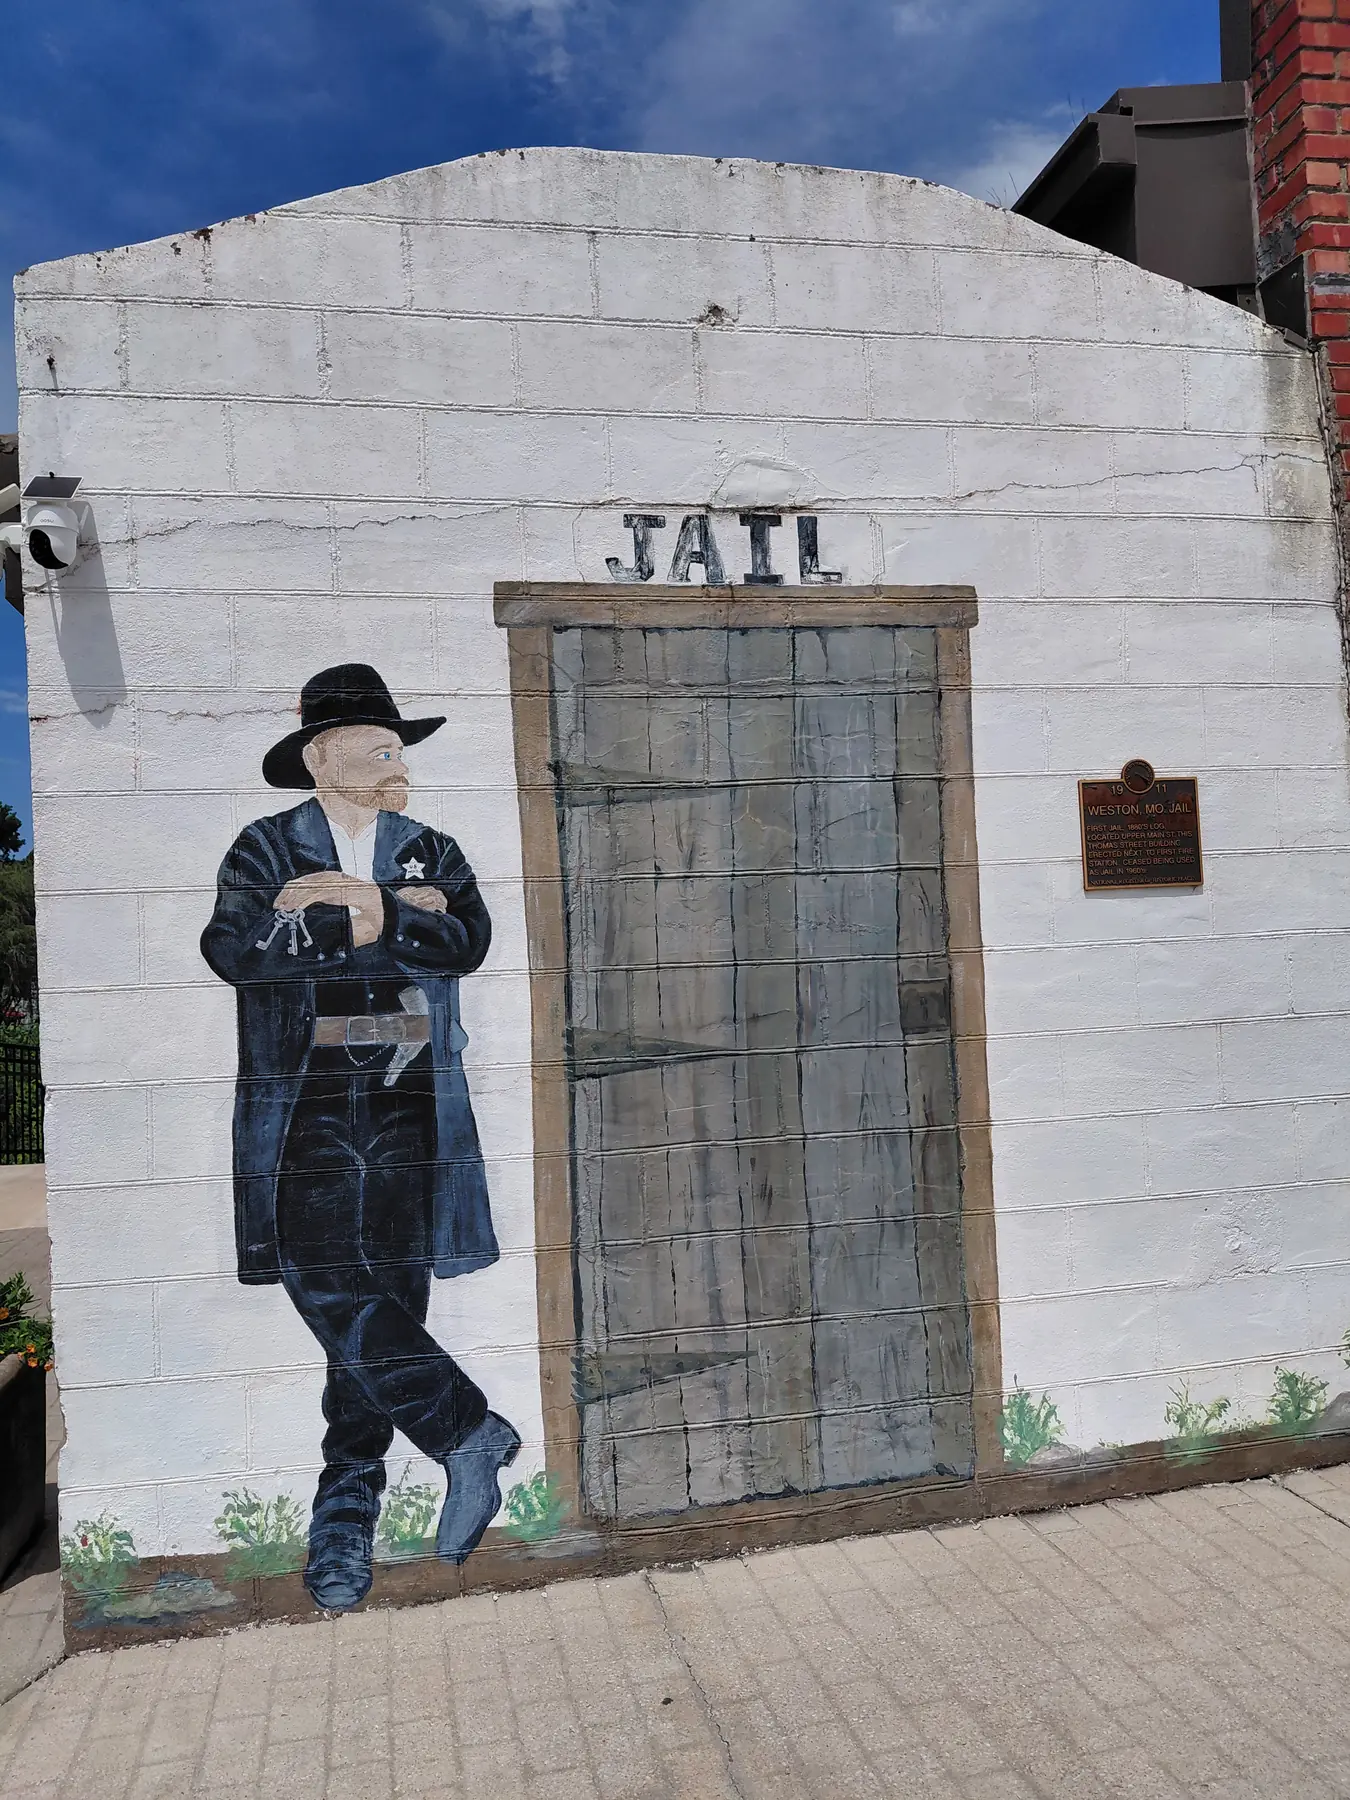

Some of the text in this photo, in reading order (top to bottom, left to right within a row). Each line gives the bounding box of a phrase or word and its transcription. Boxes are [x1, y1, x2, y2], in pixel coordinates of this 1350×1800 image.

[605, 513, 842, 586] JAIL
[1111, 784, 1167, 795] 19 11
[1088, 805, 1141, 815] WESTON,
[1169, 803, 1191, 813] JAIL
